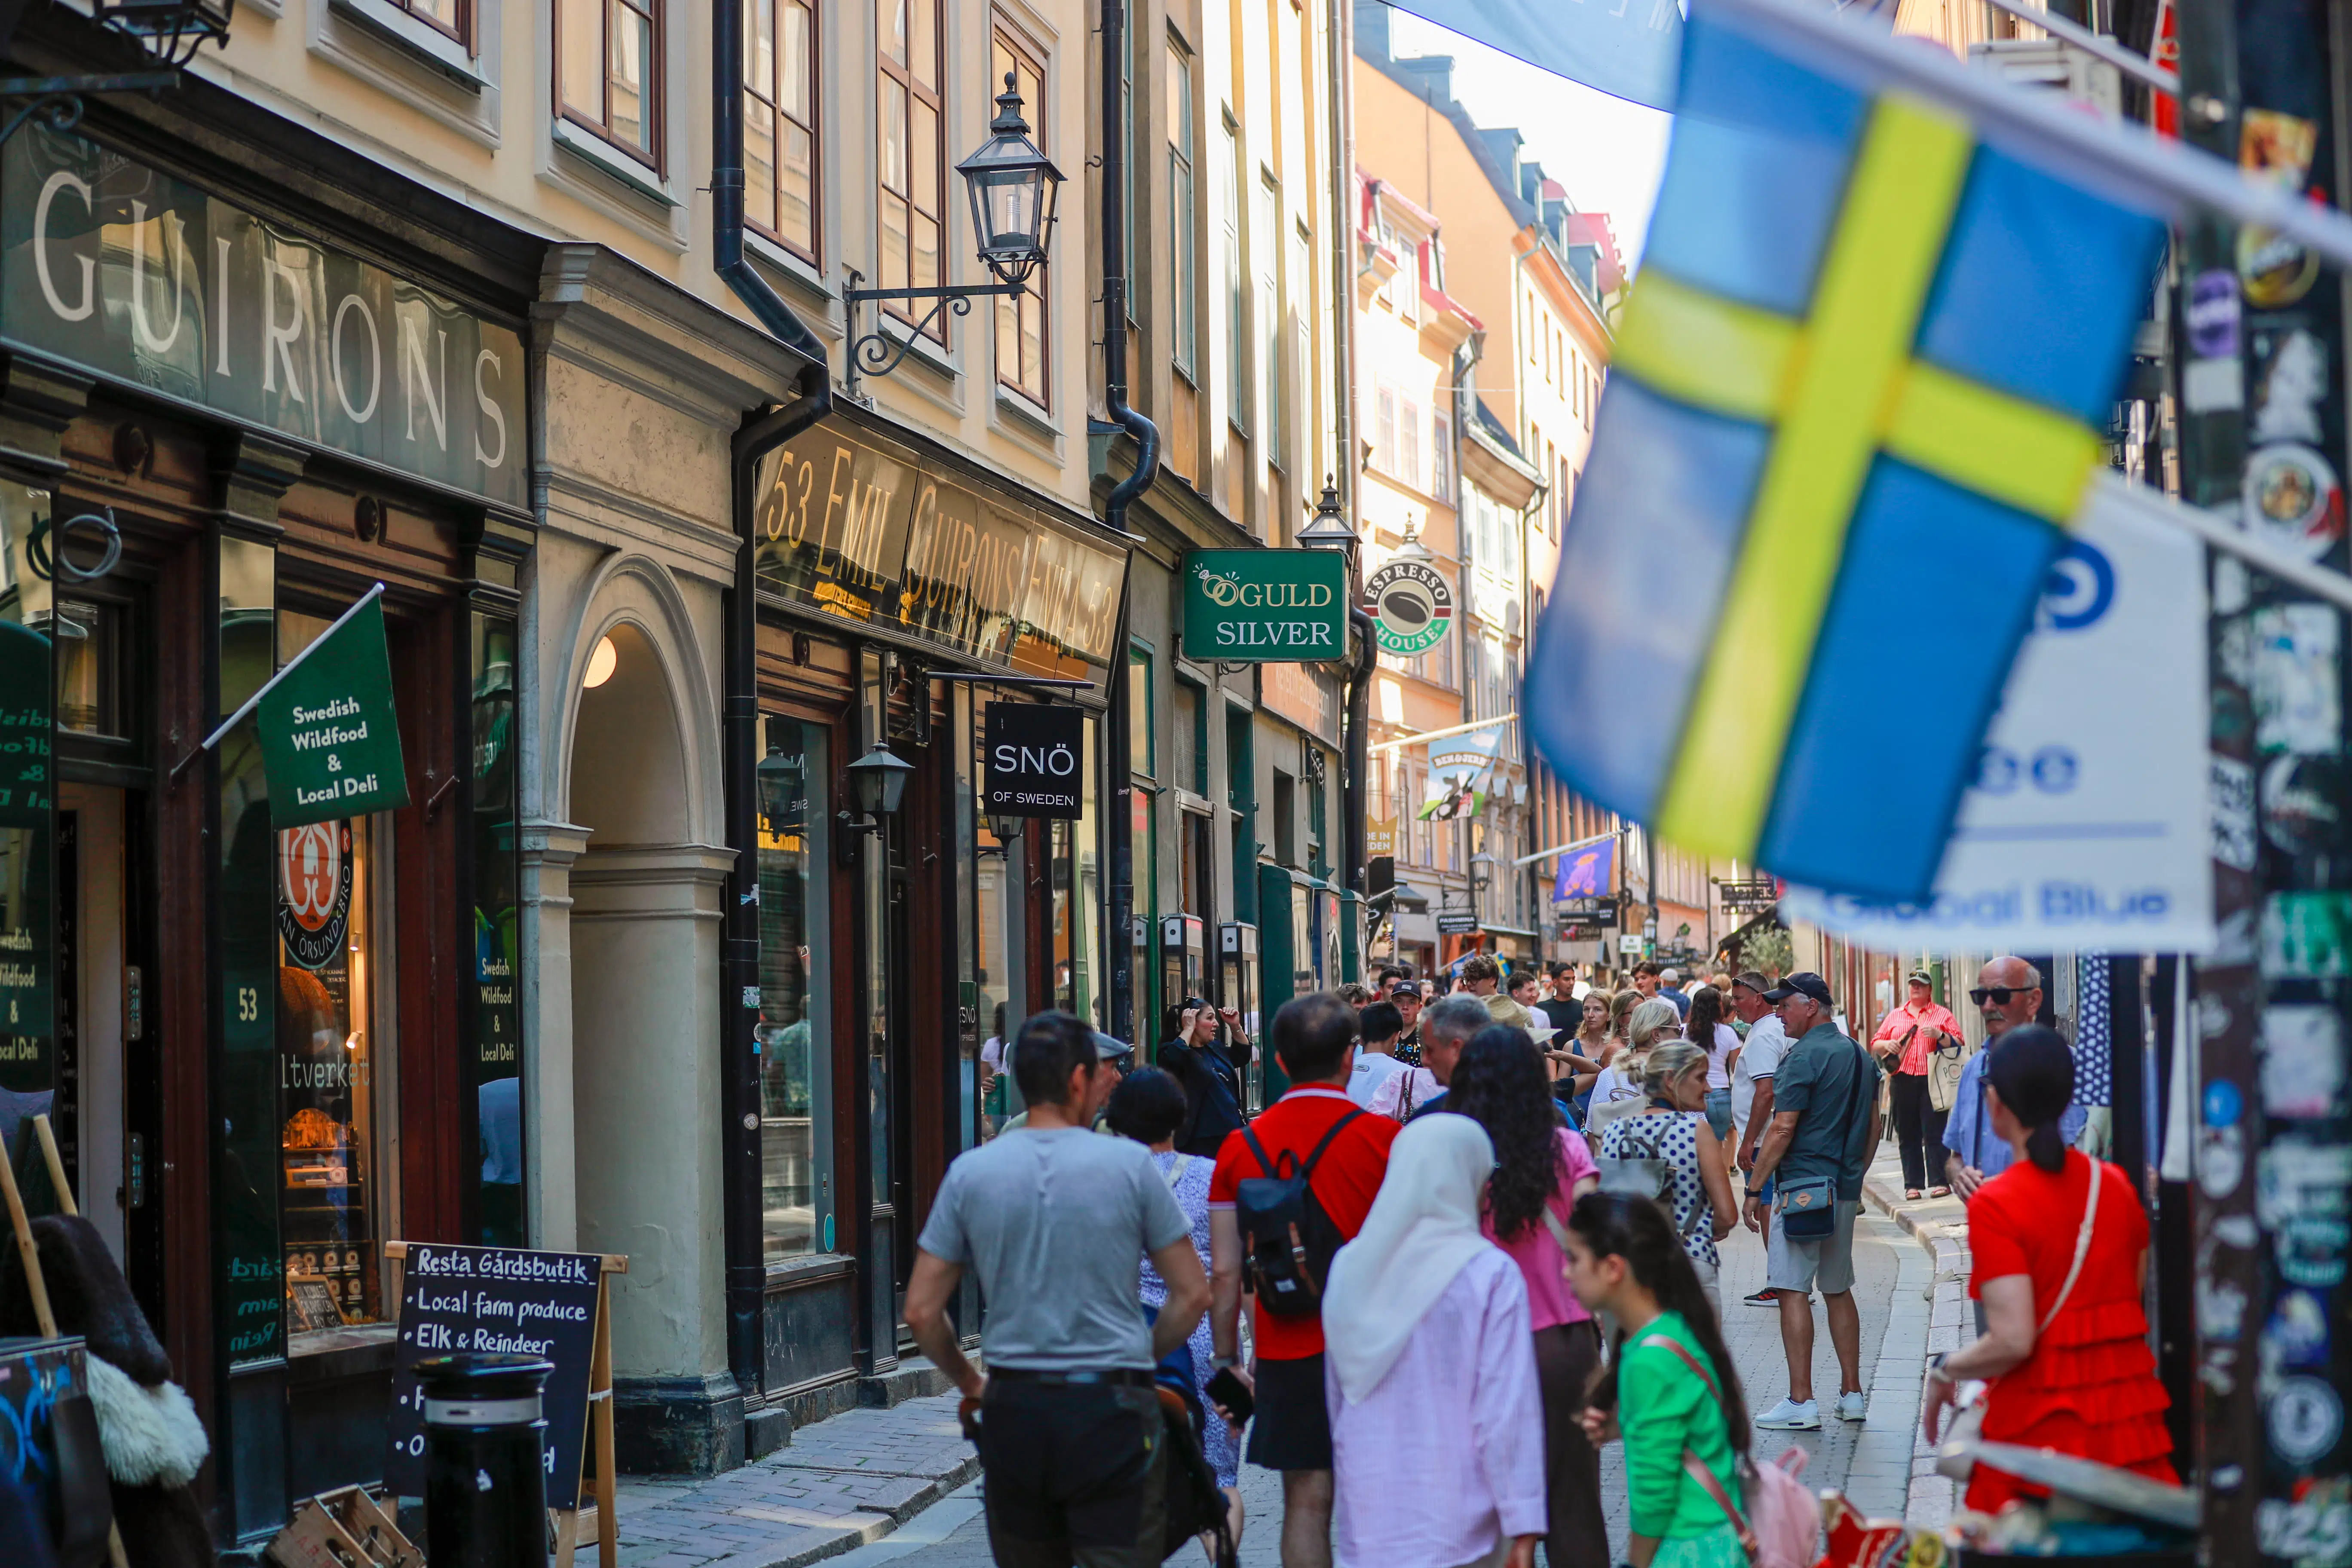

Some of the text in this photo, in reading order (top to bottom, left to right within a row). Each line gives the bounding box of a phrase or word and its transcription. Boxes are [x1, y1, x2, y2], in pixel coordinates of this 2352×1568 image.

[34, 171, 506, 467] GUIRONS
[767, 451, 812, 548] 53
[814, 446, 891, 594] EMIL
[906, 485, 1020, 627] GUIRONS
[1082, 581, 1114, 655] 53
[1240, 584, 1332, 607] GULD
[1366, 564, 1448, 601] ESPRESSO
[1216, 622, 1332, 645] SILVER
[1377, 625, 1437, 650] HOUSE
[293, 696, 360, 725] Swedish
[291, 721, 368, 751] Wildfood
[328, 753, 342, 772] &
[994, 743, 1074, 775] SNÖ
[297, 774, 378, 805] Local Deli
[993, 791, 1074, 806] OF SWEDEN
[1379, 832, 1390, 840] IN
[299, 866, 350, 959] ÖRSUNDSBRO
[1578, 927, 1600, 935] Dala
[482, 958, 509, 976] Swedish
[239, 988, 257, 1022] 53
[481, 986, 511, 1004] Wildfood
[10, 999, 18, 1024] &
[494, 1015, 500, 1033] &
[18, 1036, 38, 1060] Deli
[481, 1043, 514, 1062] Local Deli
[281, 1054, 370, 1089] ltverket
[418, 1249, 588, 1281] Resta Gårdsbutik
[419, 1288, 588, 1327] Local farm produce
[417, 1323, 554, 1355] Elk & Reindeer
